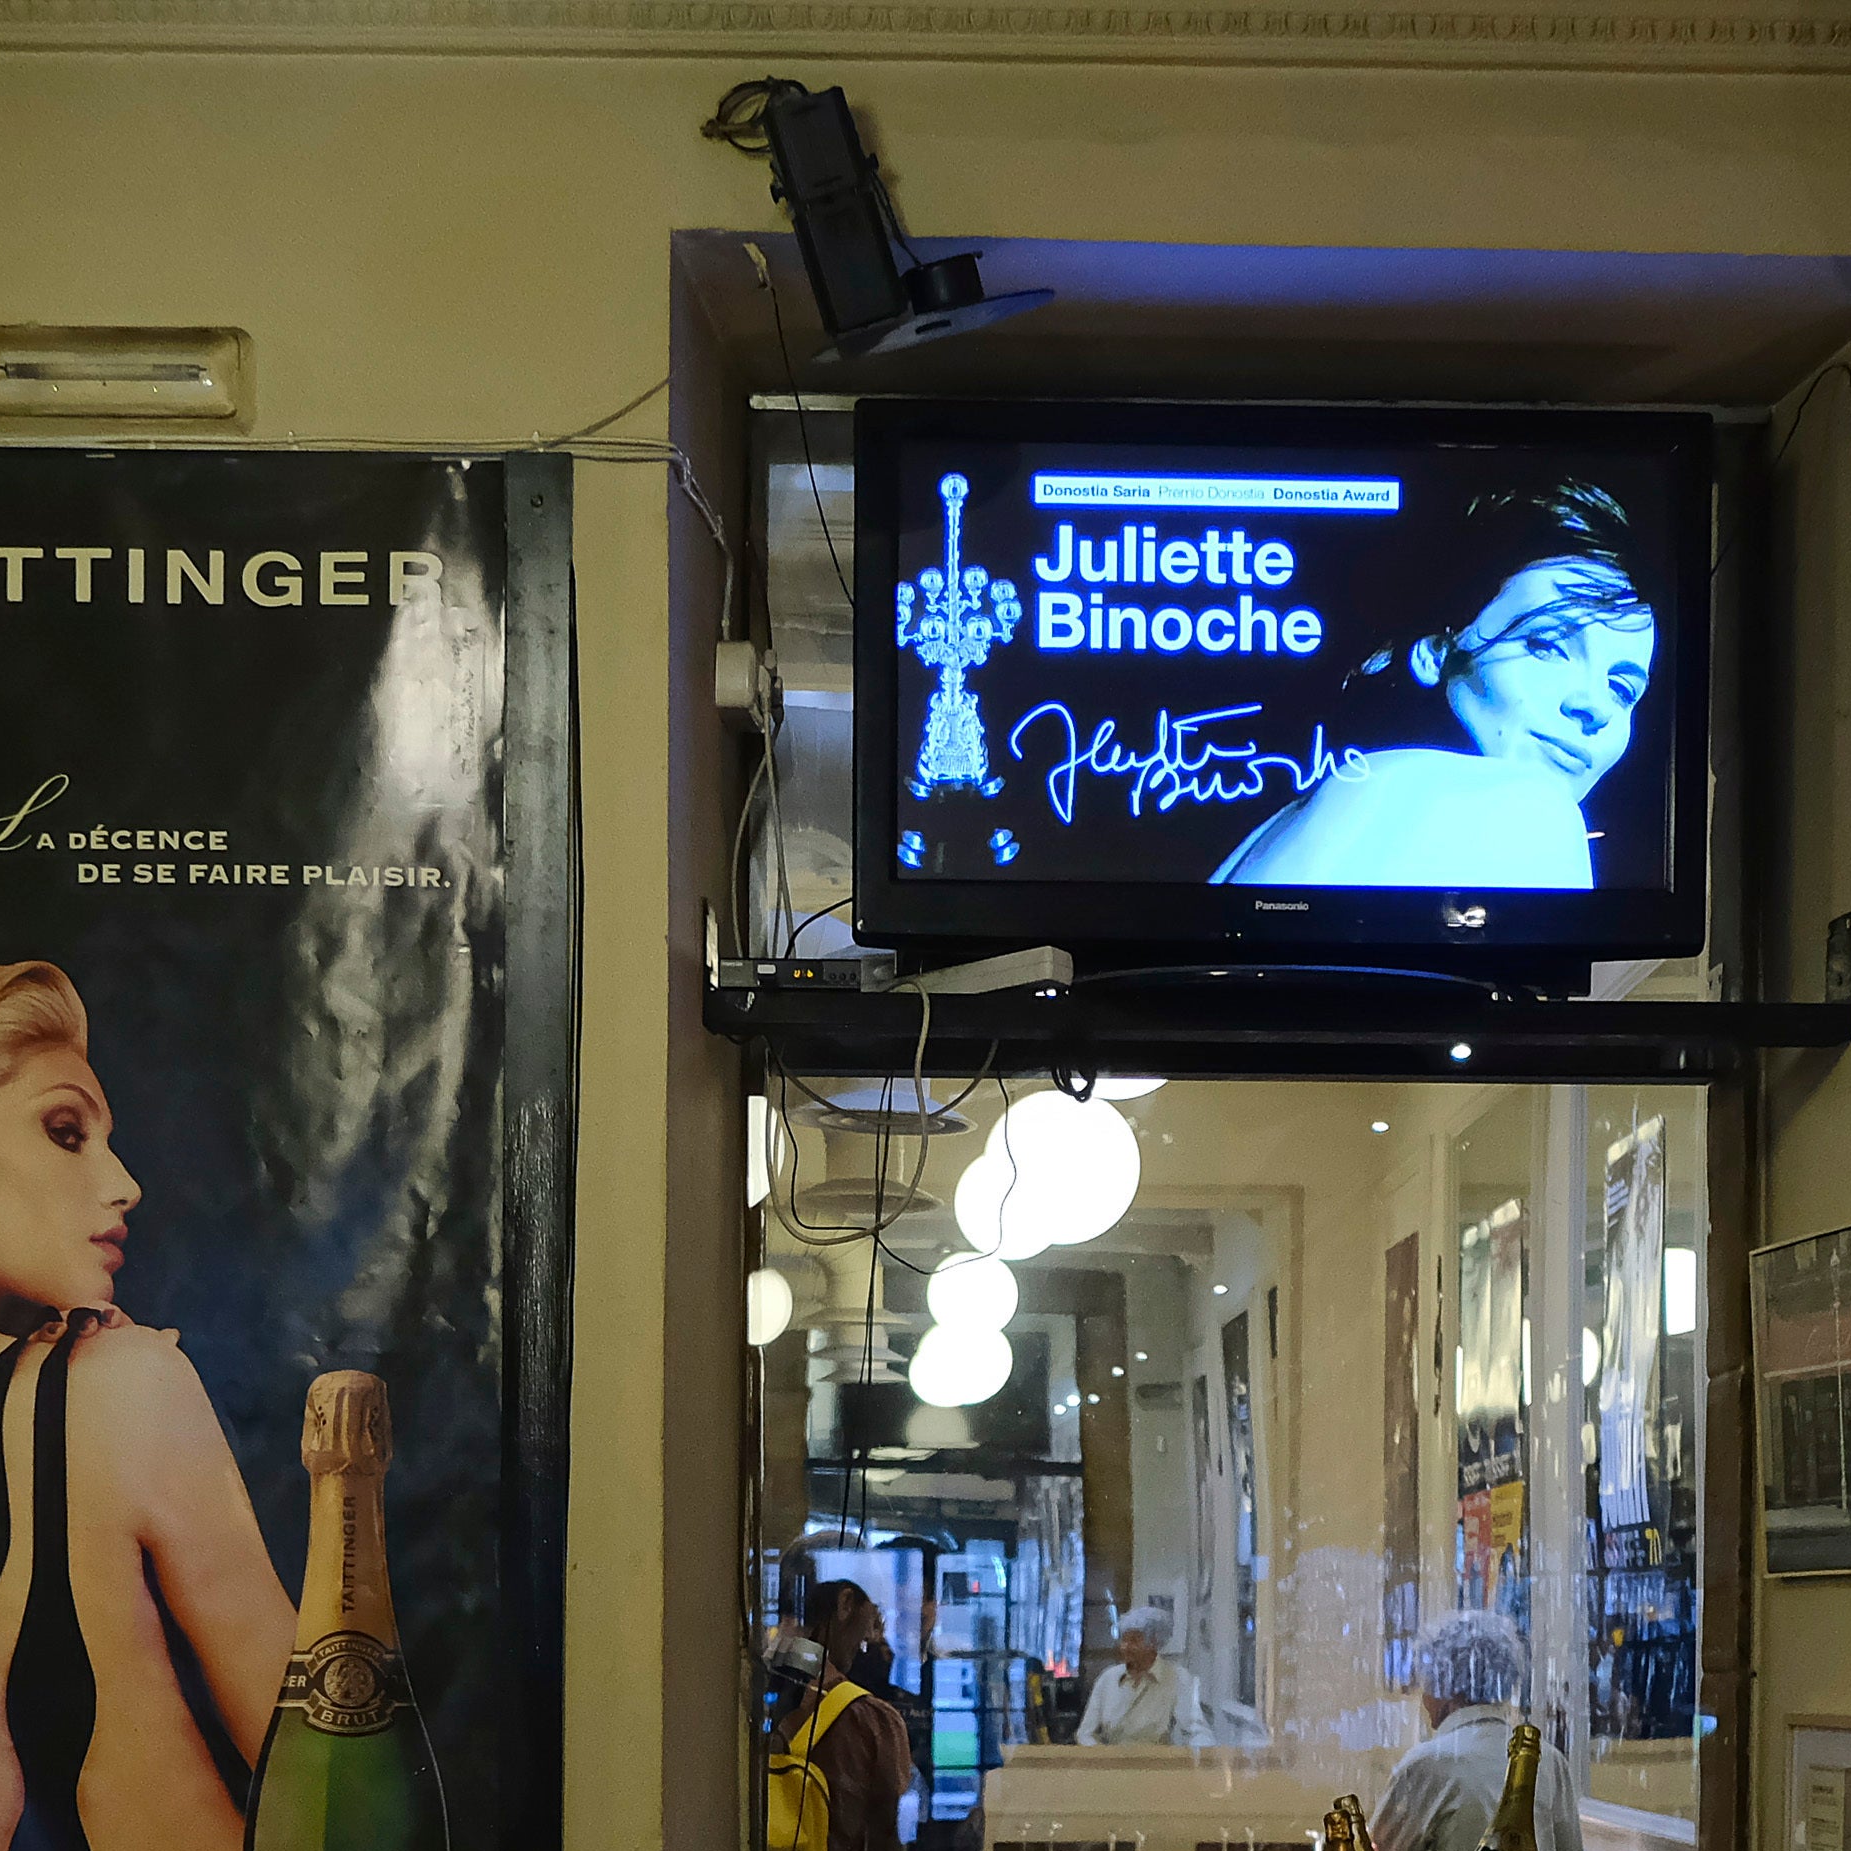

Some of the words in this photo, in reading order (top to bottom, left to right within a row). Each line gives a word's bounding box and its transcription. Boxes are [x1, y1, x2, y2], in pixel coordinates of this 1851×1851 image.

[1042, 482, 1109, 498] Donostia
[1112, 484, 1151, 498] Saria
[1157, 484, 1206, 499] Premio
[1207, 486, 1266, 501] Donostia
[1272, 487, 1339, 502] Donostia
[1342, 488, 1391, 502] Award
[1035, 522, 1295, 587] Juliette
[1037, 590, 1323, 654] Binoche
[68, 824, 229, 852] DÉCENCE
[77, 862, 123, 885] DE
[132, 864, 178, 886] SE
[188, 864, 290, 887] FAIRE
[301, 864, 452, 889] PLAISIR.
[1255, 900, 1309, 911] Panasonic
[342, 1496, 357, 1613] TAITTINGER
[320, 1710, 379, 1726] BRUT
